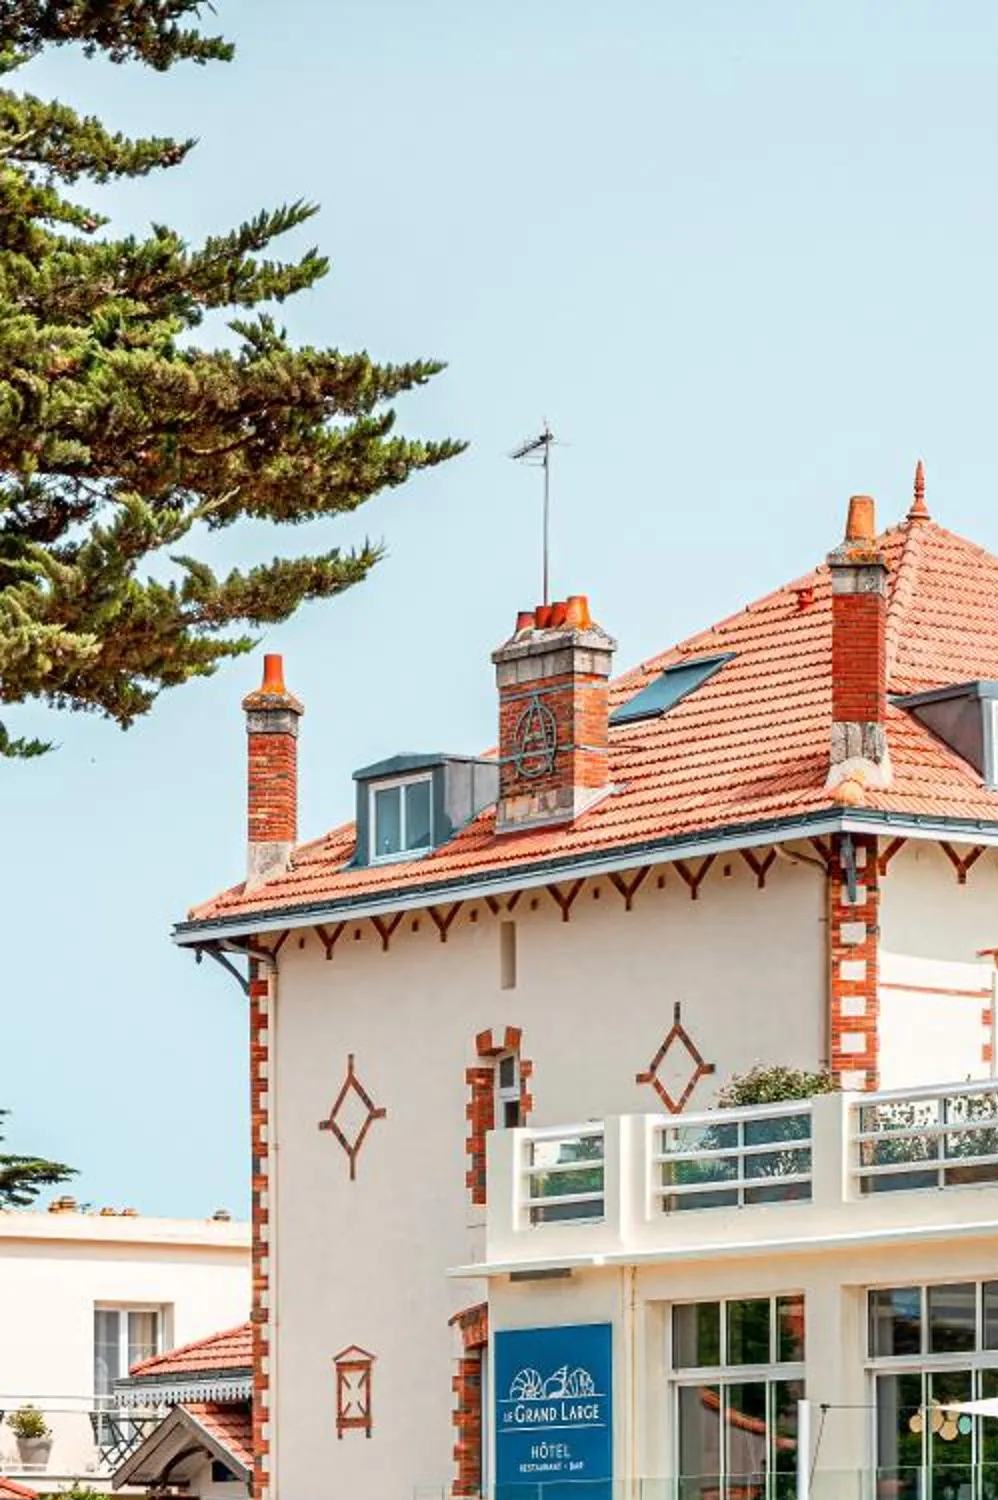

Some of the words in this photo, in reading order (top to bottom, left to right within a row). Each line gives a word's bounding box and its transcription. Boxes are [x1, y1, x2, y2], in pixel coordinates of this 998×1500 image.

[515, 1404, 557, 1423] GRAND
[561, 1401, 600, 1421] LARGE
[531, 1441, 571, 1459] HÔTEL
